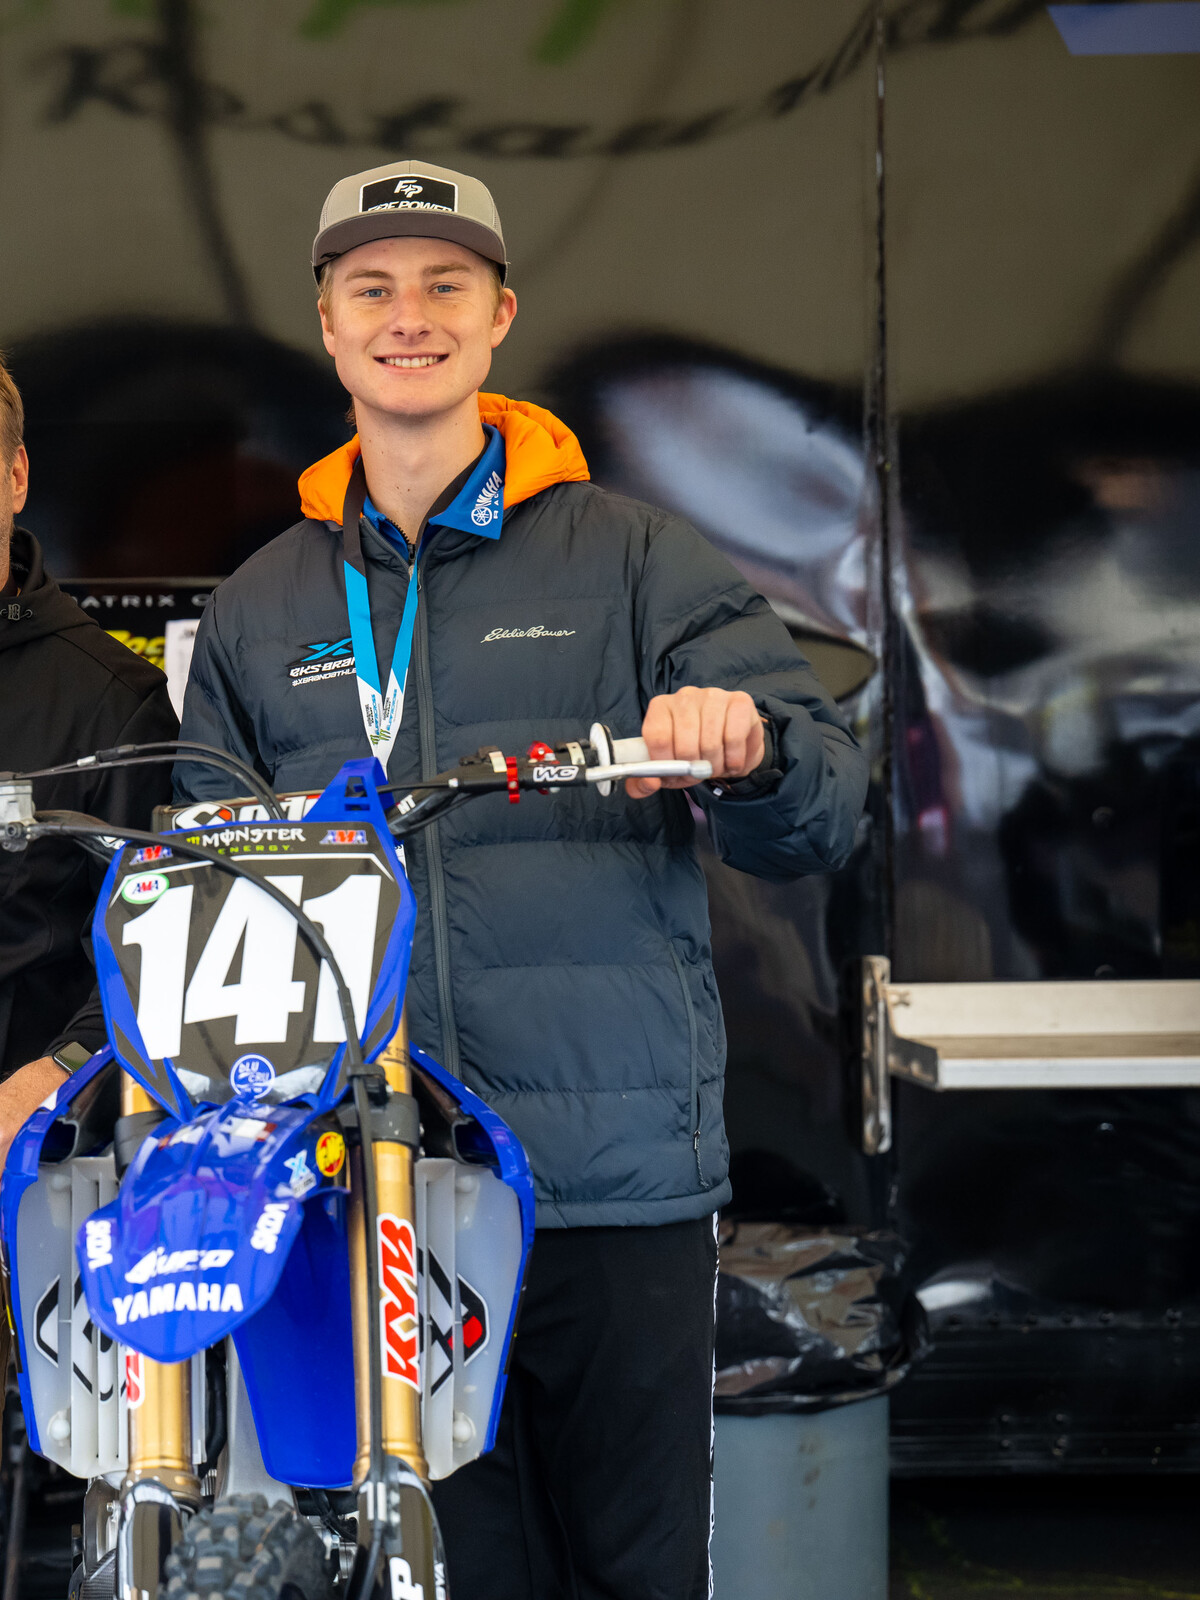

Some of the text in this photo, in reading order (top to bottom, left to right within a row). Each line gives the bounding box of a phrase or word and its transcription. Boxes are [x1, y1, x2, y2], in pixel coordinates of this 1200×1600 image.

[394, 180, 423, 198] FP
[73, 594, 176, 608] ATRIX
[480, 625, 576, 643] Eddie Bauer
[322, 657, 355, 671] BRA
[292, 668, 356, 687] #XBRANDATHLE
[203, 827, 307, 848] MONSTER
[319, 829, 368, 845] AMA
[129, 845, 173, 865] AMA
[218, 844, 291, 854] ENERGY
[132, 880, 159, 894] AMA
[122, 874, 381, 1060] 141
[112, 1282, 244, 1325] YAMAHA
[378, 1216, 421, 1390] KYB
